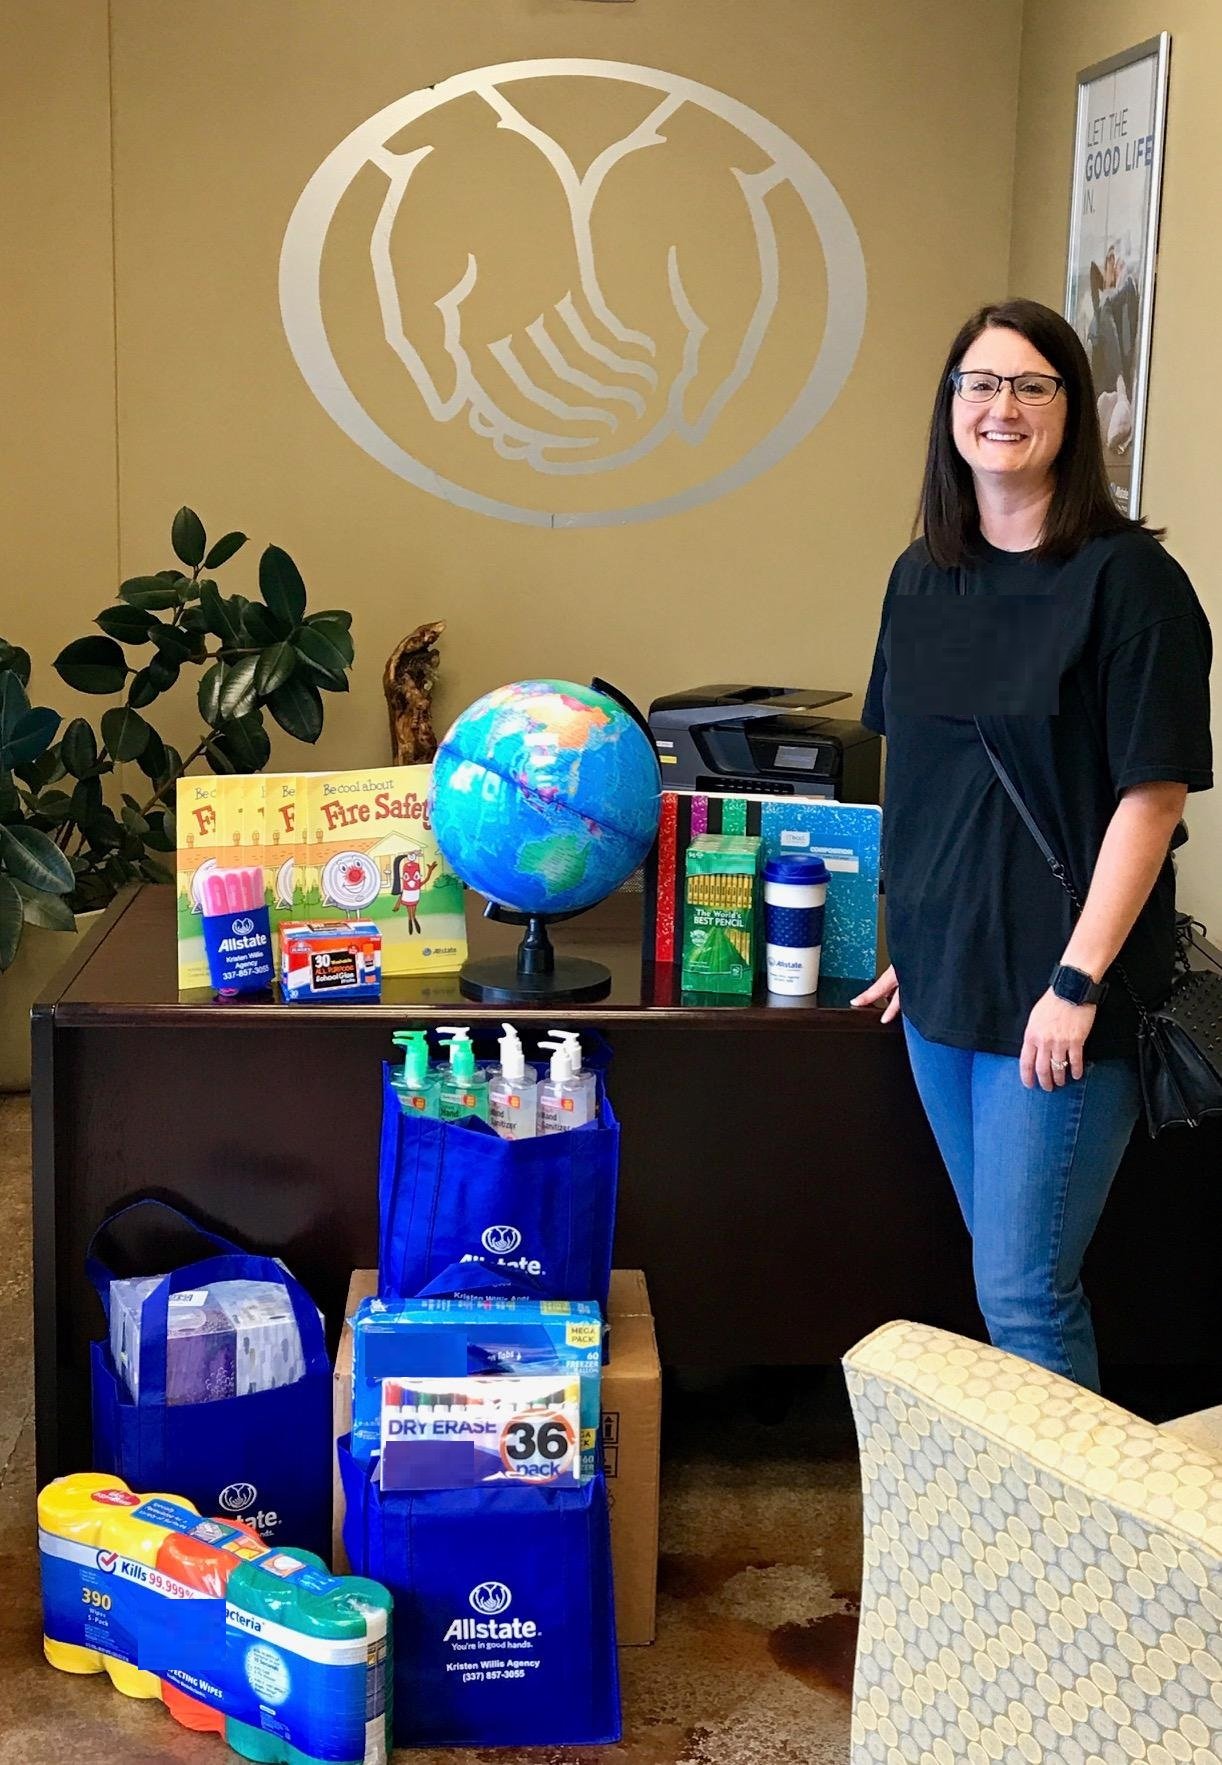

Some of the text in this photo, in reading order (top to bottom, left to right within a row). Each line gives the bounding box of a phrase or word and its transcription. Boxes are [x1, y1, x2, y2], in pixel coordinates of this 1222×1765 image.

[1087, 108, 1128, 148] LET THE
[1086, 135, 1153, 181] GOOD LIFE
[323, 779, 394, 796] Be cool about
[320, 800, 370, 830] Fire
[693, 916, 744, 928] BEST PENCIL
[217, 933, 267, 953] Allstate
[314, 953, 331, 969] 30
[571, 1327, 595, 1335] MEGA
[586, 1351, 600, 1361] 60
[389, 1419, 497, 1435] DRY ERASE
[506, 1421, 568, 1460] 36
[121, 1561, 147, 1582] Kills
[81, 1587, 113, 1611] 390
[452, 1640, 534, 1650] You're in good hands.
[446, 1659, 541, 1672] Kristen Willis Agency
[462, 1669, 526, 1683] (337) 857-3055
